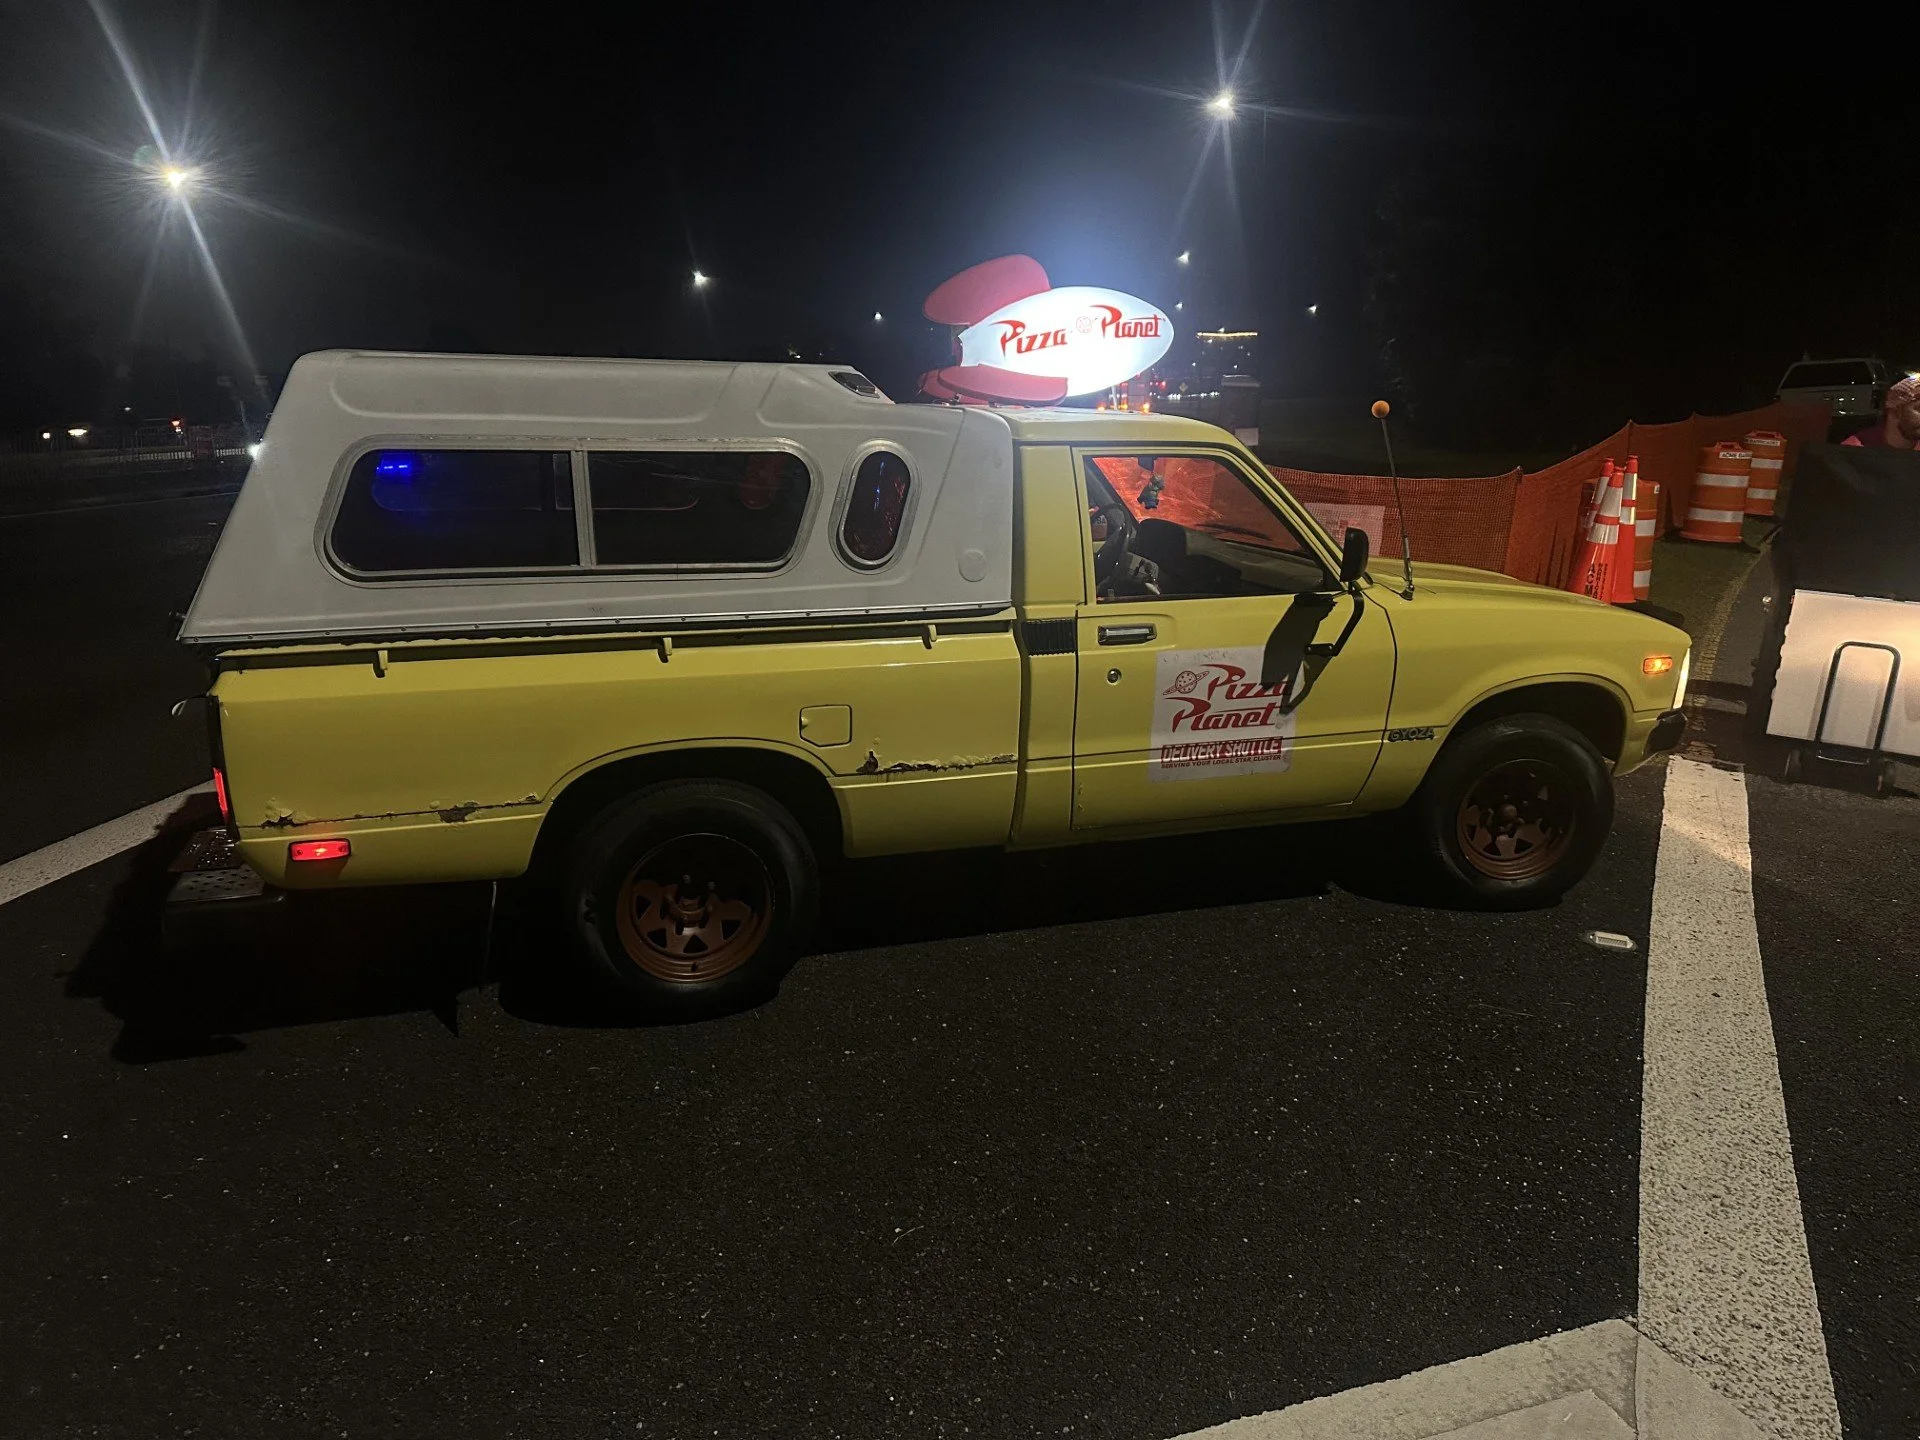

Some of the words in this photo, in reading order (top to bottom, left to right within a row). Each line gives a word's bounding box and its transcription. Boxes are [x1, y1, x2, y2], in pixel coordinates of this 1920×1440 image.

[988, 319, 1068, 358] Pizza
[1089, 304, 1166, 338] Planet
[1164, 696, 1281, 733] Planet
[1162, 742, 1222, 761] DELIVERY
[1224, 736, 1280, 757] SHUTTLE
[1391, 728, 1434, 740] GYOZA
